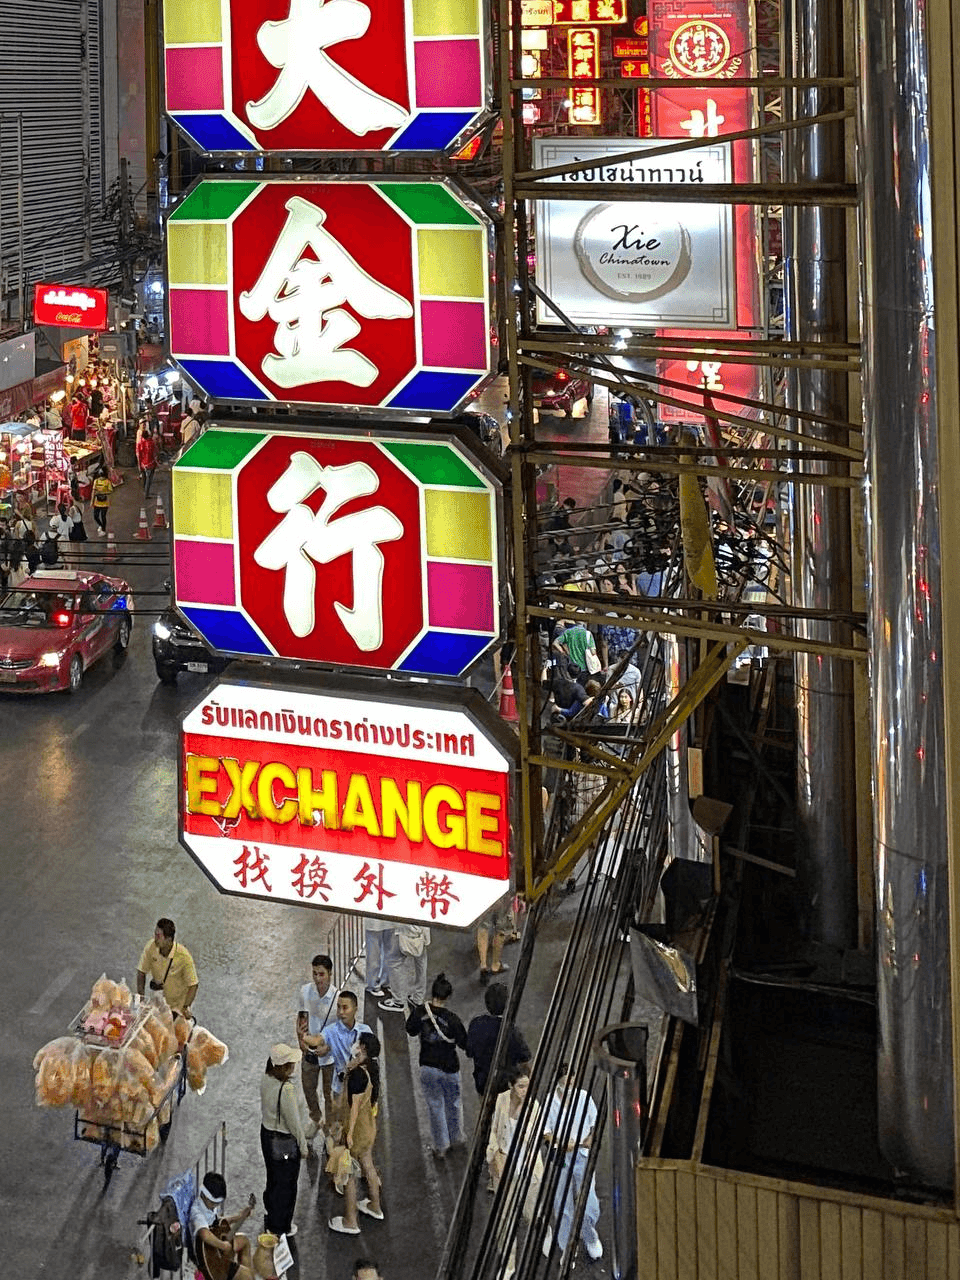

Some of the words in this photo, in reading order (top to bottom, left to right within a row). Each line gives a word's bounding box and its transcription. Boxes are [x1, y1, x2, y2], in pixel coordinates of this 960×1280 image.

[611, 224, 661, 250] Xie
[599, 252, 671, 266] Chinatown
[201, 700, 475, 757] รับแลกเงินตราต่างประเทศ
[187, 753, 503, 858] EXCHANGE
